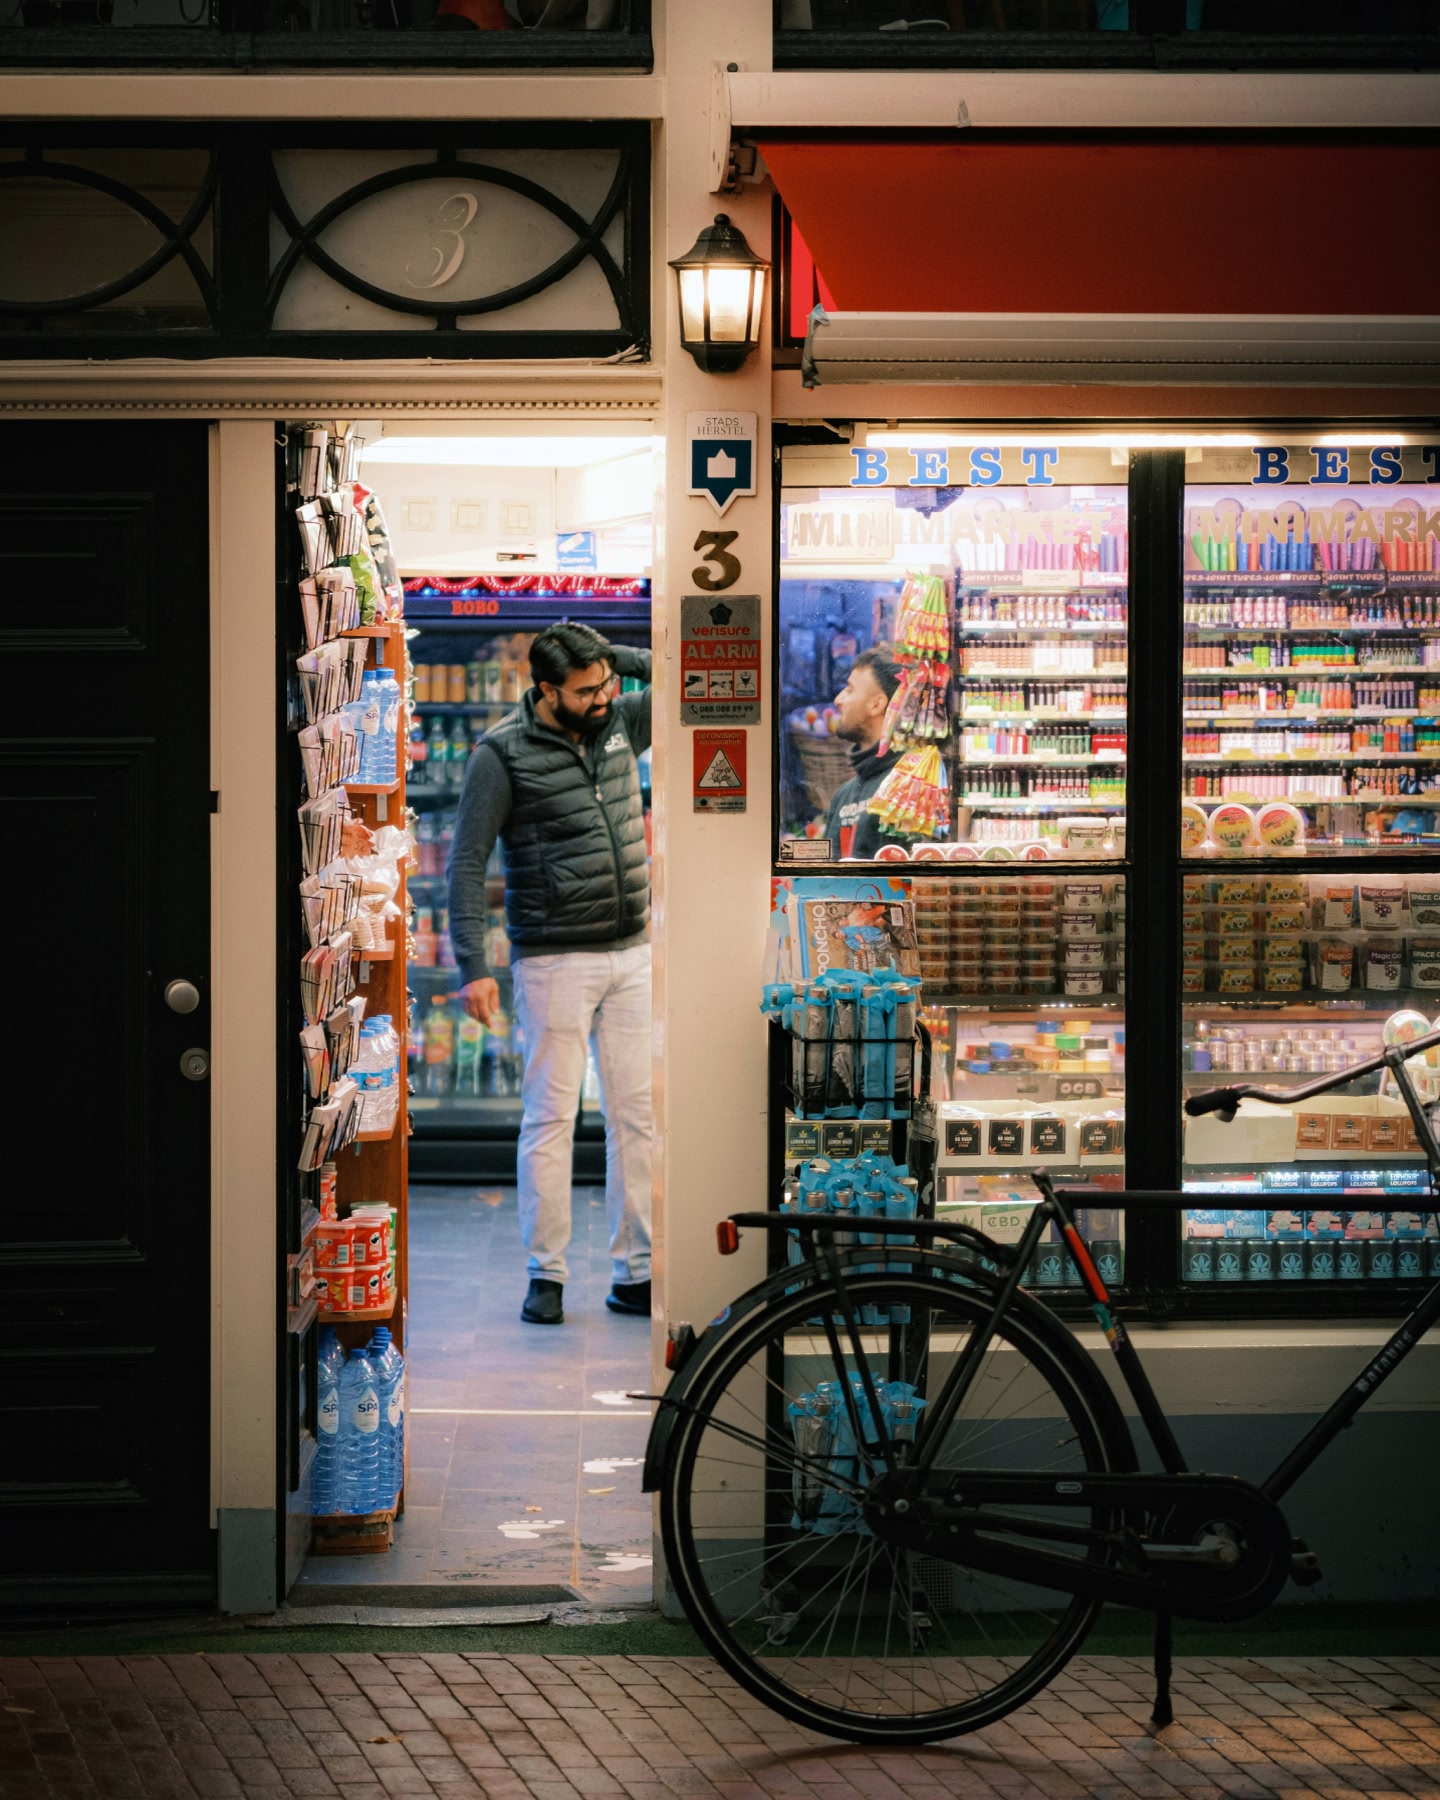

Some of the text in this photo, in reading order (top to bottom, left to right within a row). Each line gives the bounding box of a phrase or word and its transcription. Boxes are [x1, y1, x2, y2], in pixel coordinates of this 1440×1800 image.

[405, 192, 478, 289] 3
[705, 417, 739, 426] STADS
[697, 426, 748, 435] HERSTEL
[850, 446, 1058, 486] BEST
[691, 530, 741, 590] 3
[691, 626, 750, 636] verisure
[684, 643, 758, 659] ALARM
[812, 904, 831, 976] PONCHO
[1060, 1082, 1097, 1094] OCB
[987, 1216, 1020, 1227] CBD
